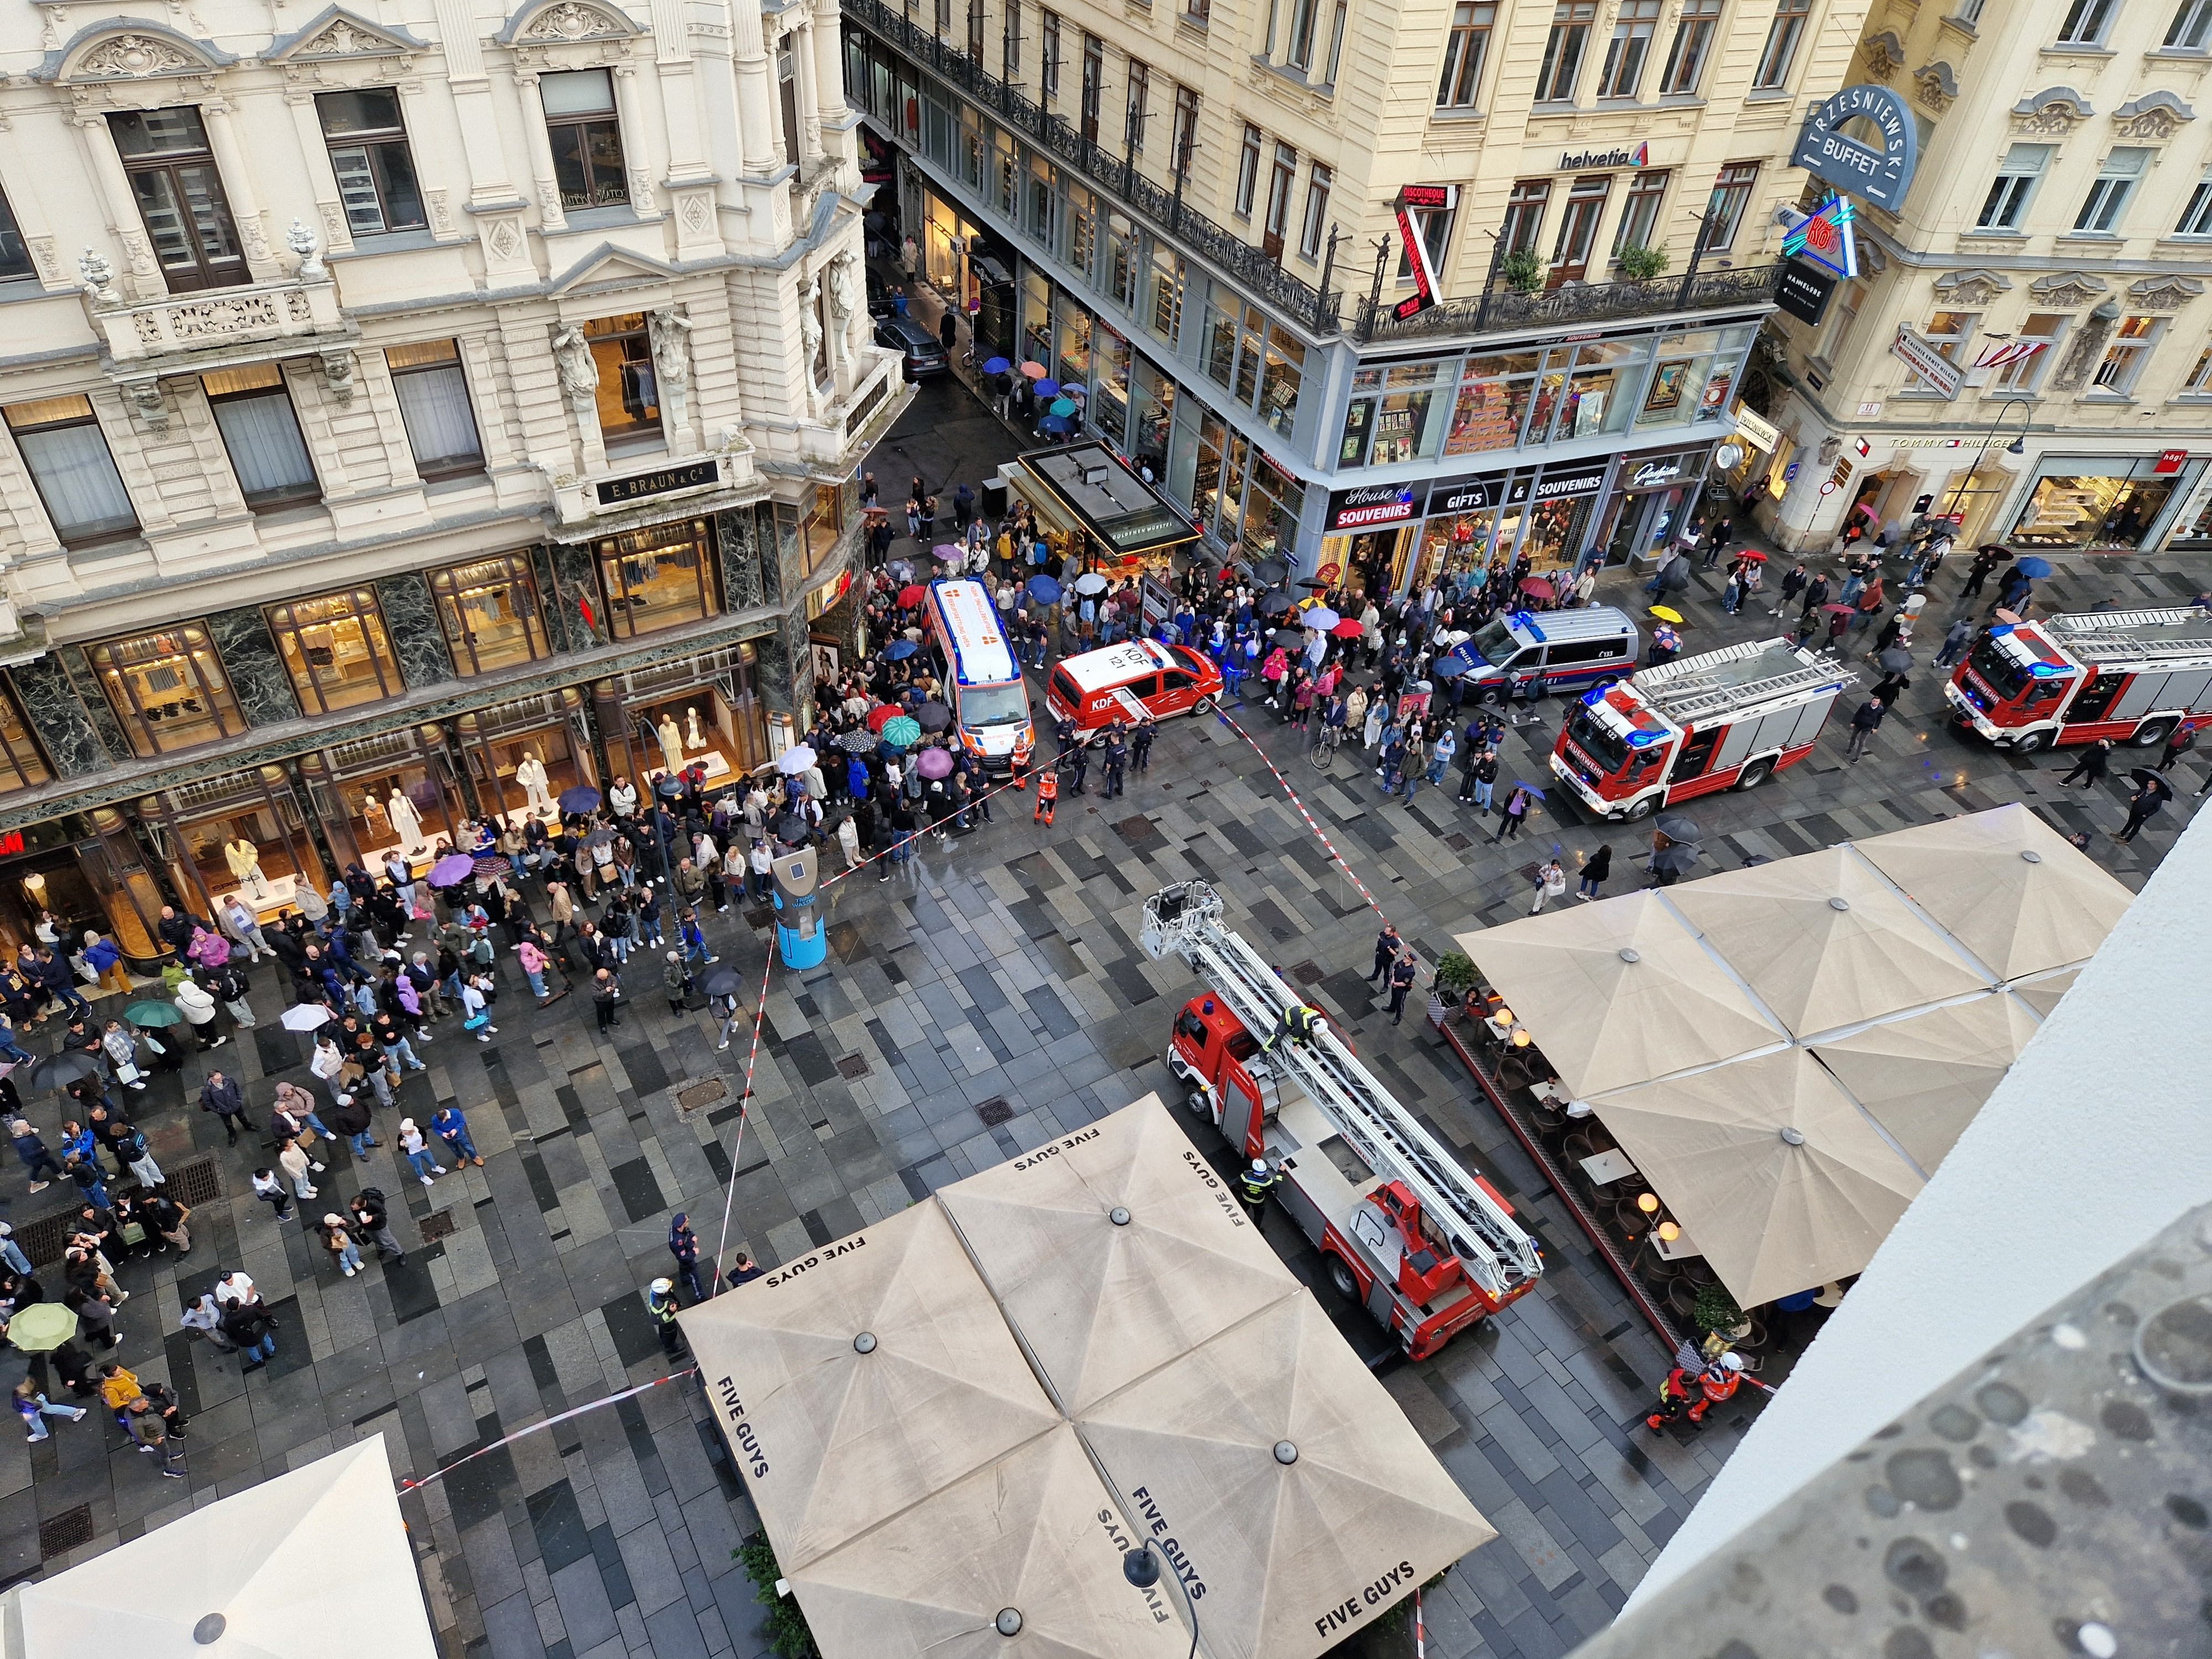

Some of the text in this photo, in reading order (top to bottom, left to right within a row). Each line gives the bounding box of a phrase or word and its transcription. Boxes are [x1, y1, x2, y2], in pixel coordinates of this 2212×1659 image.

[1807, 88, 1904, 180] TRZEŚNIEWSKI
[1559, 147, 1630, 170] helvetia
[1822, 137, 1881, 177] BUFFET
[1403, 186, 1445, 200] DISCOTHEQUE
[1397, 211, 1429, 299] FLEDERMAUS
[1406, 298, 1420, 312] BAR
[1566, 332, 1603, 342] SOUVENIRS
[1897, 346, 1930, 375] SINDBADS
[1929, 371, 1953, 395] REISEN
[1907, 339, 1926, 358] GALERIE
[1926, 353, 1941, 369] ERNST
[1939, 365, 1958, 383] HILGER
[1192, 393, 1213, 414] House
[1890, 439, 2016, 448] TOMMY HILFIGER
[2163, 453, 2184, 462] högl
[1262, 450, 1297, 482] SOUVENIRS
[612, 484, 625, 498] E.
[629, 472, 676, 494] BRAUN
[680, 474, 687, 484] &
[1345, 481, 1414, 505] House of
[1447, 475, 1602, 509] GIFTS & SOUVENIRS
[1338, 503, 1412, 526] SOUVENIRS
[1112, 527, 1146, 541] GOLDENEN
[947, 598, 971, 648] BERUFSRETTUNG WIEN
[969, 585, 994, 634] BERUFSRETTUNG WIEN
[1108, 655, 1126, 669] 121
[1121, 648, 1150, 667] KDF
[1457, 646, 1475, 666] POLIZEI
[1990, 639, 2021, 670] NOTRUF 122
[1965, 667, 2001, 705] FEUERWEHR
[1092, 696, 1114, 711] KDF
[1422, 694, 1433, 711] NEOS
[1585, 709, 1618, 741] NOTRUF 122
[1566, 738, 1605, 778] FEUERWEHR
[212, 873, 260, 893] SPRING
[795, 893, 814, 903] TRINK
[1014, 1128, 1100, 1171] FIVE GUYS
[1342, 1131, 1371, 1165] MAGIRUS
[1183, 1150, 1245, 1228] FIVE GUYS
[766, 1236, 866, 1288] FIVE GUYS
[717, 1375, 769, 1479] FIVE GUYS
[1132, 1486, 1208, 1600] FIVE GUYS
[1097, 1509, 1170, 1624] FIV UYS
[1314, 1560, 1416, 1638] FIVE GUYS
